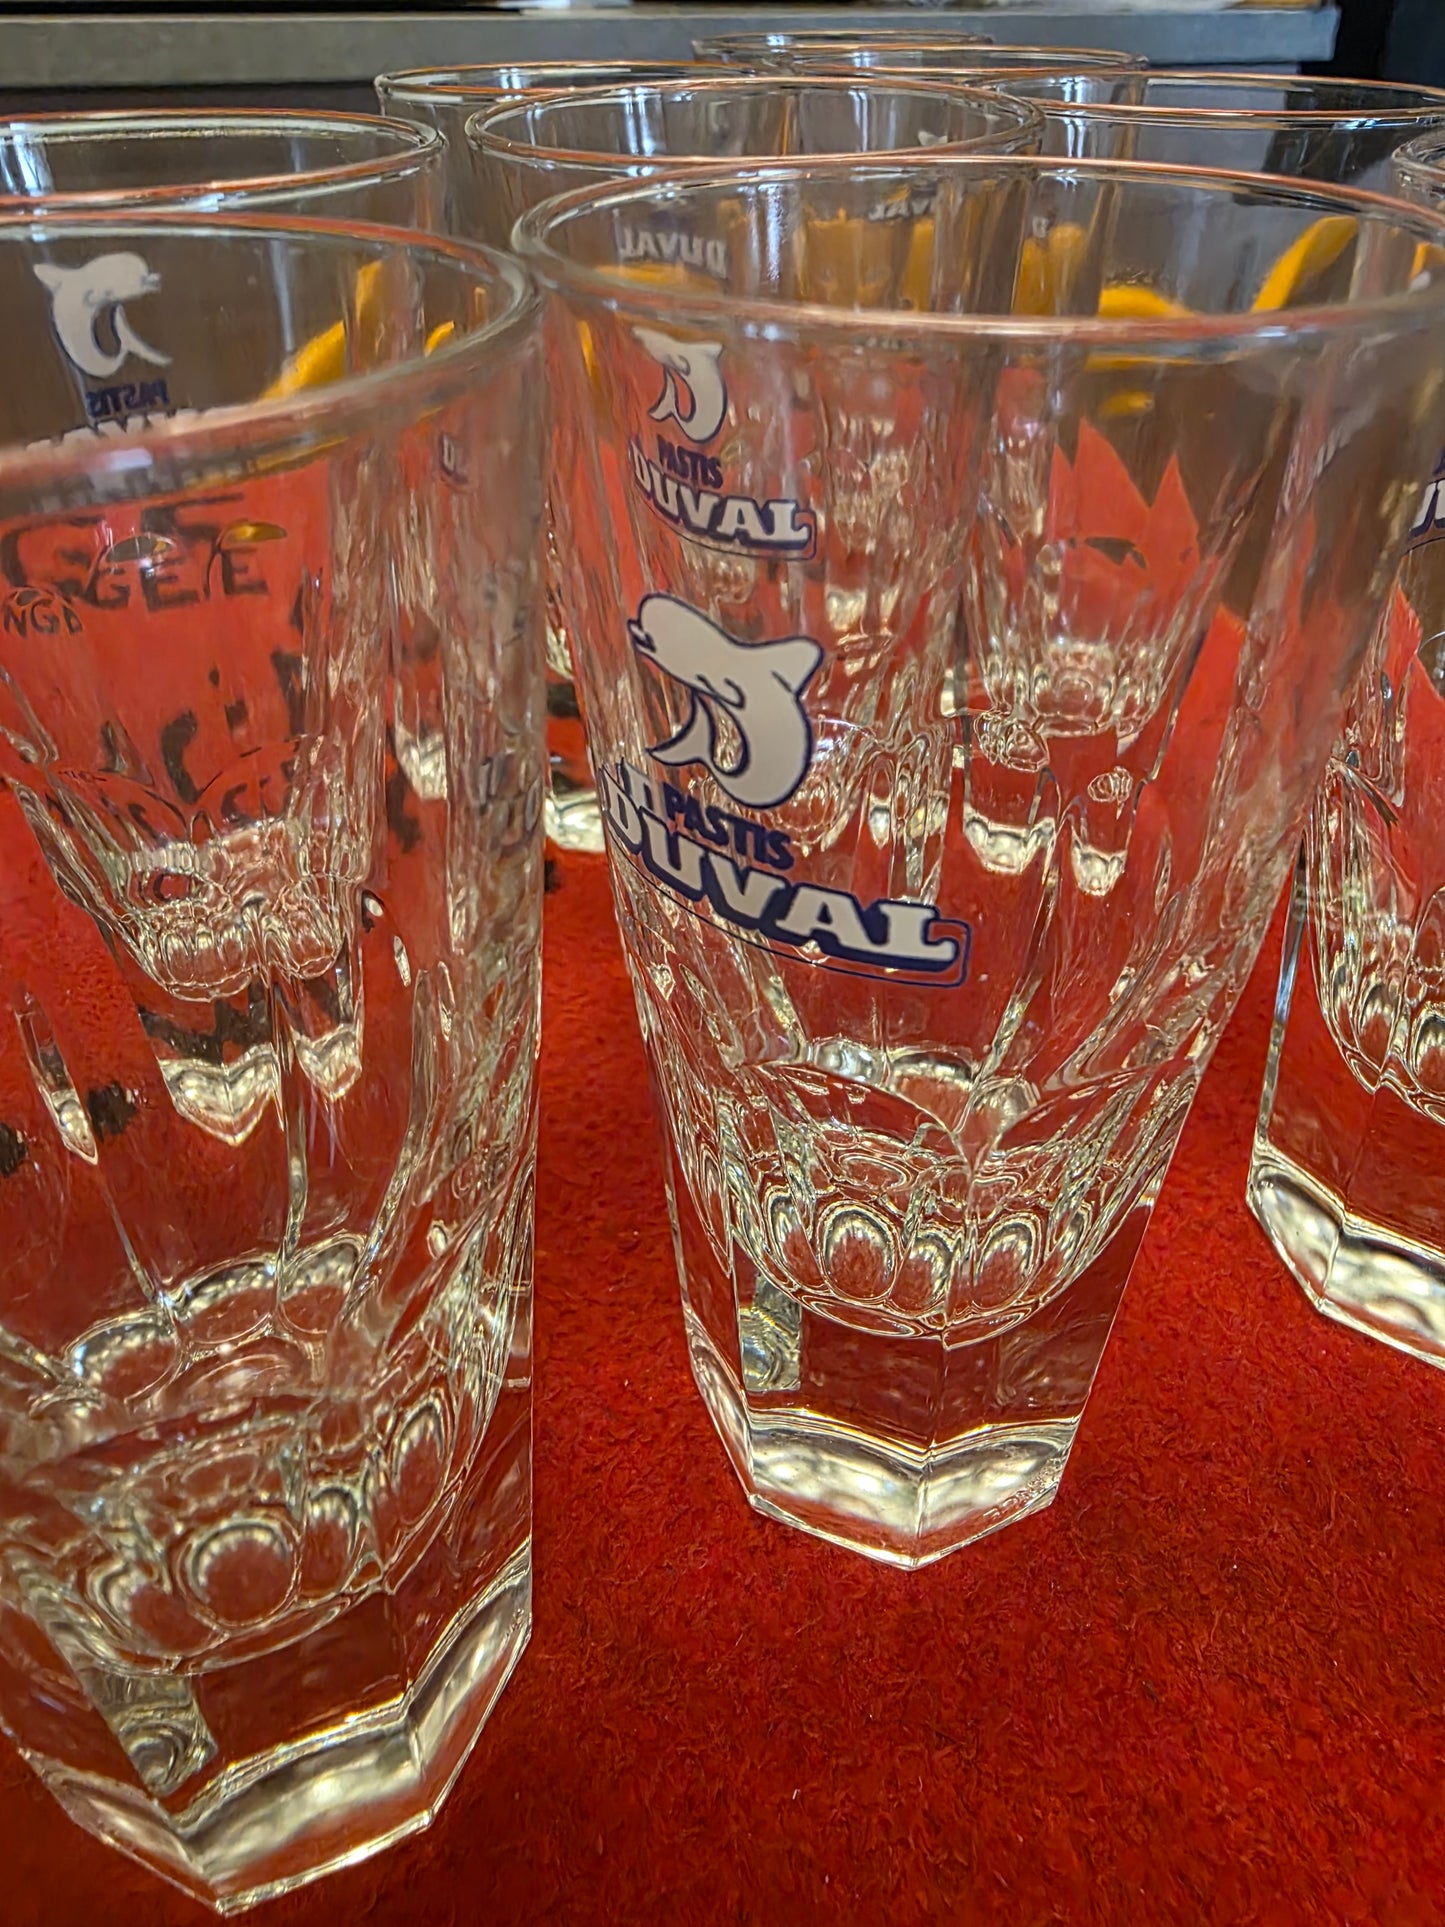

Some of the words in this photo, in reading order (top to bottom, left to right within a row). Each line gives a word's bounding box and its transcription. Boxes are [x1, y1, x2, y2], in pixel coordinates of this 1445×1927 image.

[631, 440, 812, 550] DUVAL
[657, 434, 724, 489] PASTIS
[601, 764, 961, 971] DUVAL
[662, 781, 794, 870] PASTIS
